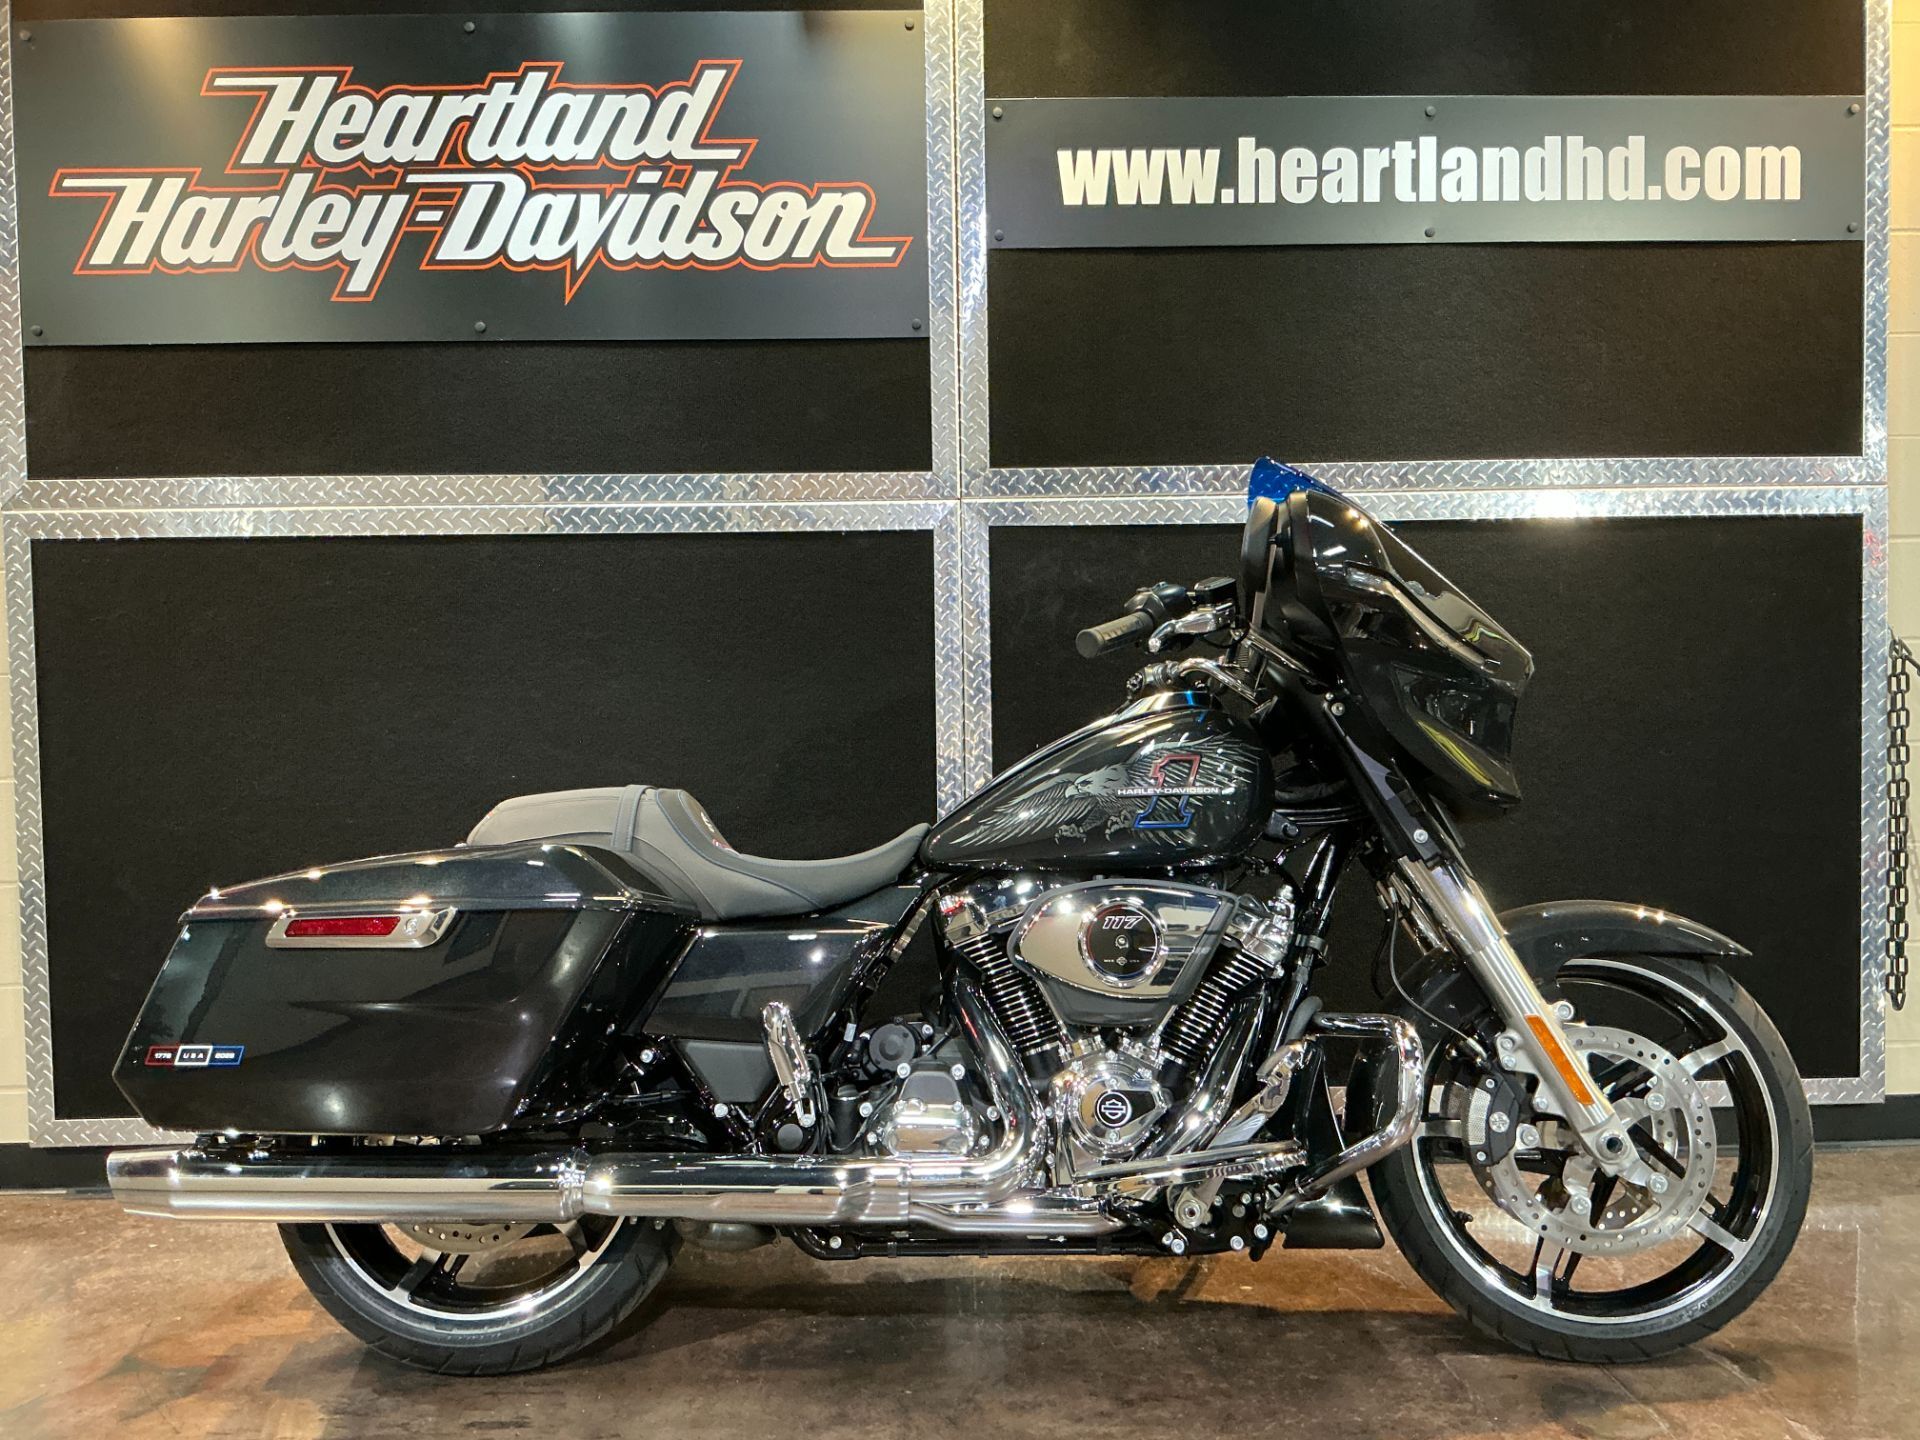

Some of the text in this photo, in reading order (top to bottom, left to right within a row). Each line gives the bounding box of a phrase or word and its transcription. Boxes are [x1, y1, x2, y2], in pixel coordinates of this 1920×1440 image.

[211, 68, 744, 166] Heartland
[1056, 134, 1802, 206] www.heartlandhd.com
[60, 168, 908, 293] Harley-Davidson
[1117, 786, 1219, 796] HARLEY-DAVIDSON
[1102, 915, 1143, 930] 117
